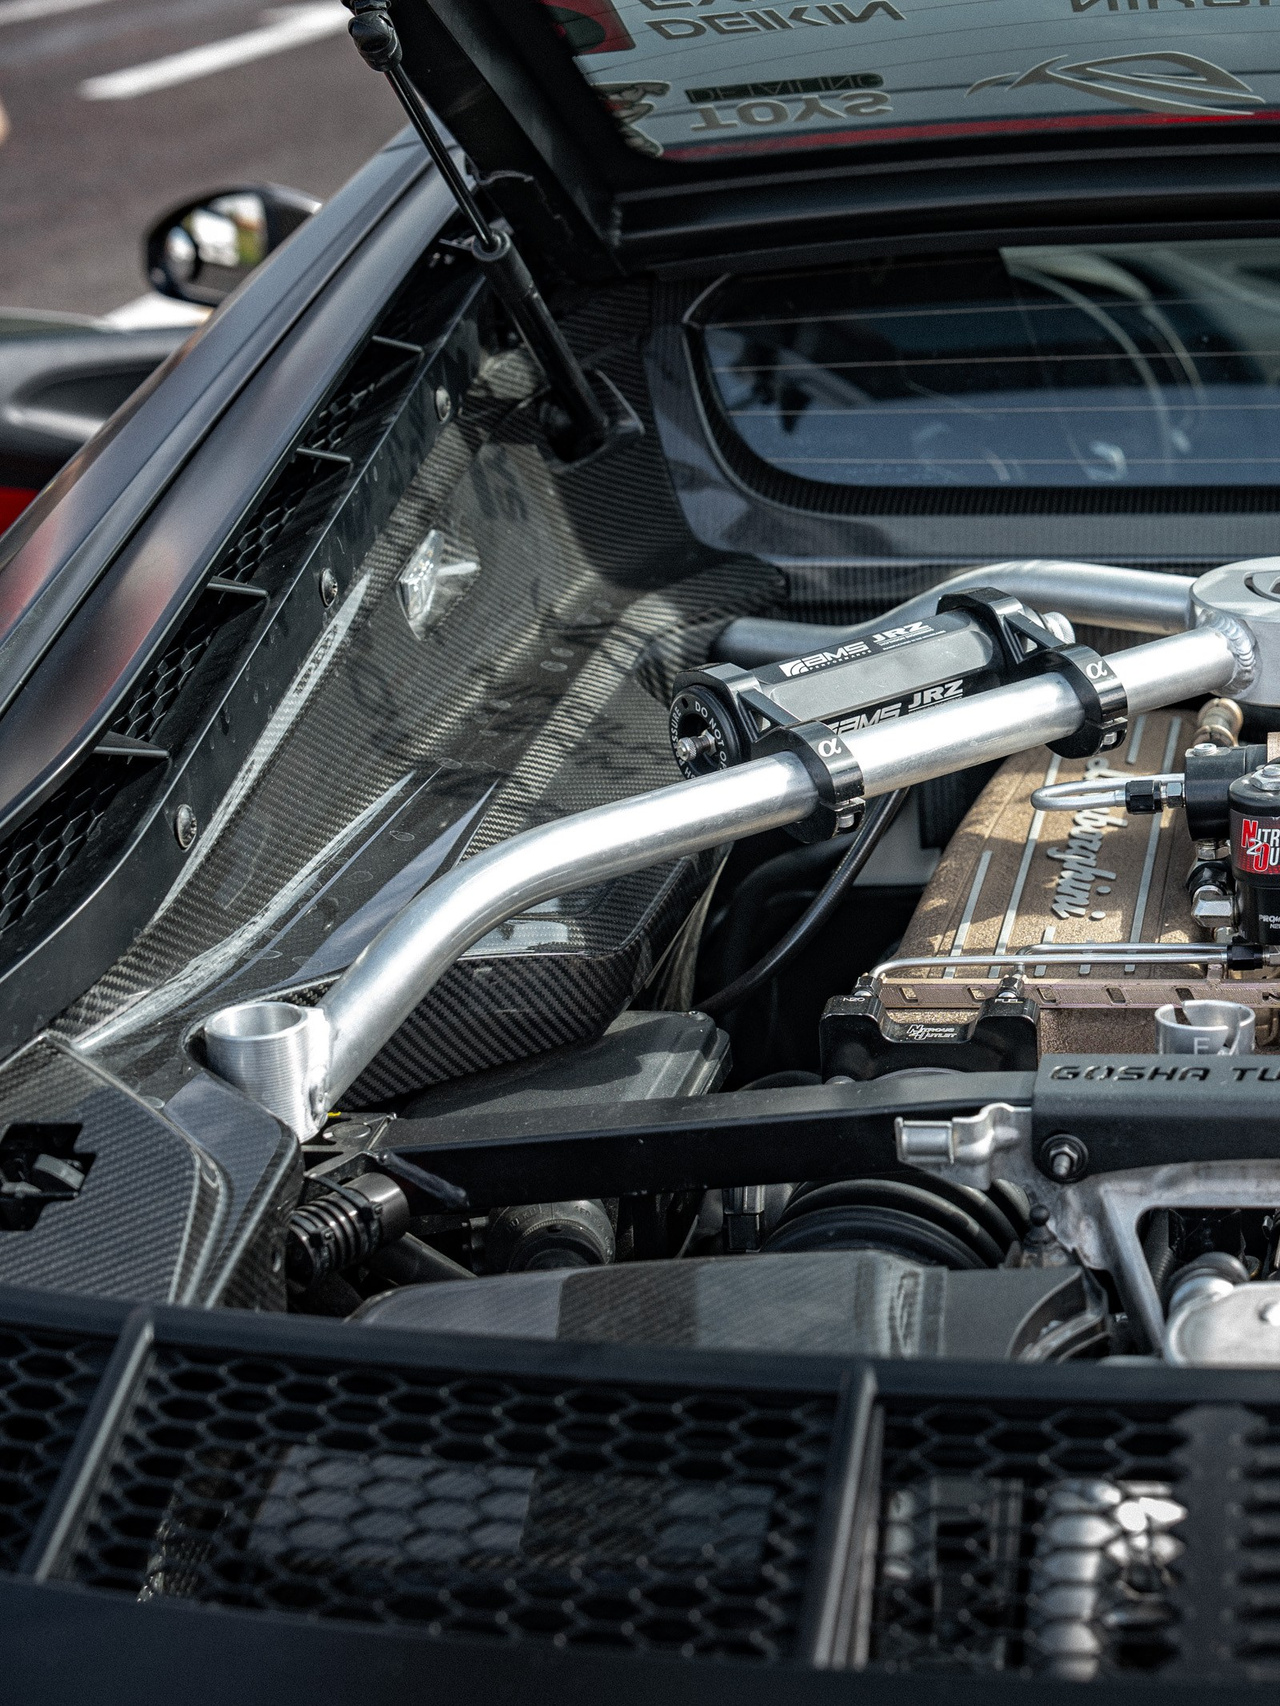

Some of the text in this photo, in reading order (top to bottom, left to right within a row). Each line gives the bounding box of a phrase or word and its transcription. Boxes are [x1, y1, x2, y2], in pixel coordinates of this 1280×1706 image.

[872, 622, 928, 643] JRZ
[803, 641, 870, 664] AMS
[908, 679, 963, 709] JRZ
[695, 701, 708, 718] DO
[708, 718, 725, 746] NOT
[1046, 756, 1136, 919] Lborghini
[1049, 1065, 1211, 1082] GOSHA
